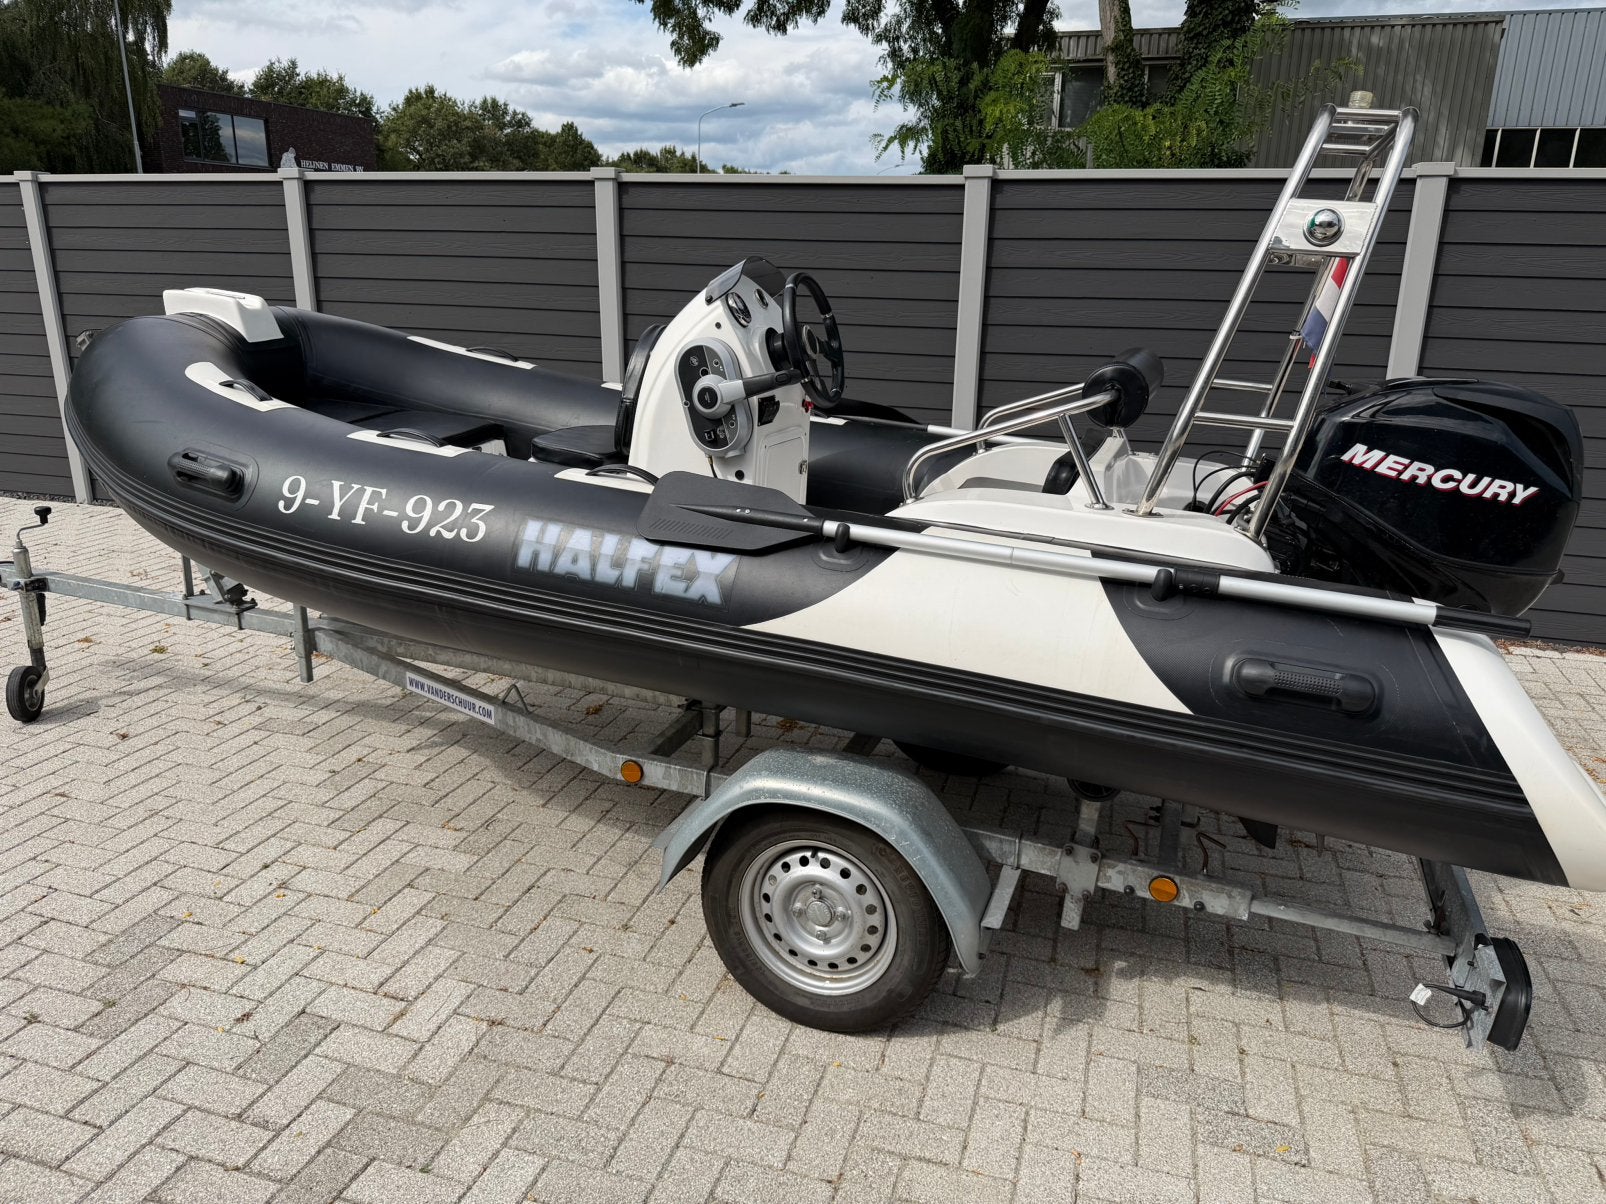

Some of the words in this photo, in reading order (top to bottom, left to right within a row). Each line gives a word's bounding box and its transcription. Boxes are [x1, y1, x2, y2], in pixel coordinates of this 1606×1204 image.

[331, 163, 354, 172] EMMEN
[1340, 443, 1540, 506] MERCURY
[278, 475, 495, 543] 9-YF-923
[516, 518, 738, 607] HALFEX
[408, 676, 493, 721] WWW.VANDERSCHUUR.COM
